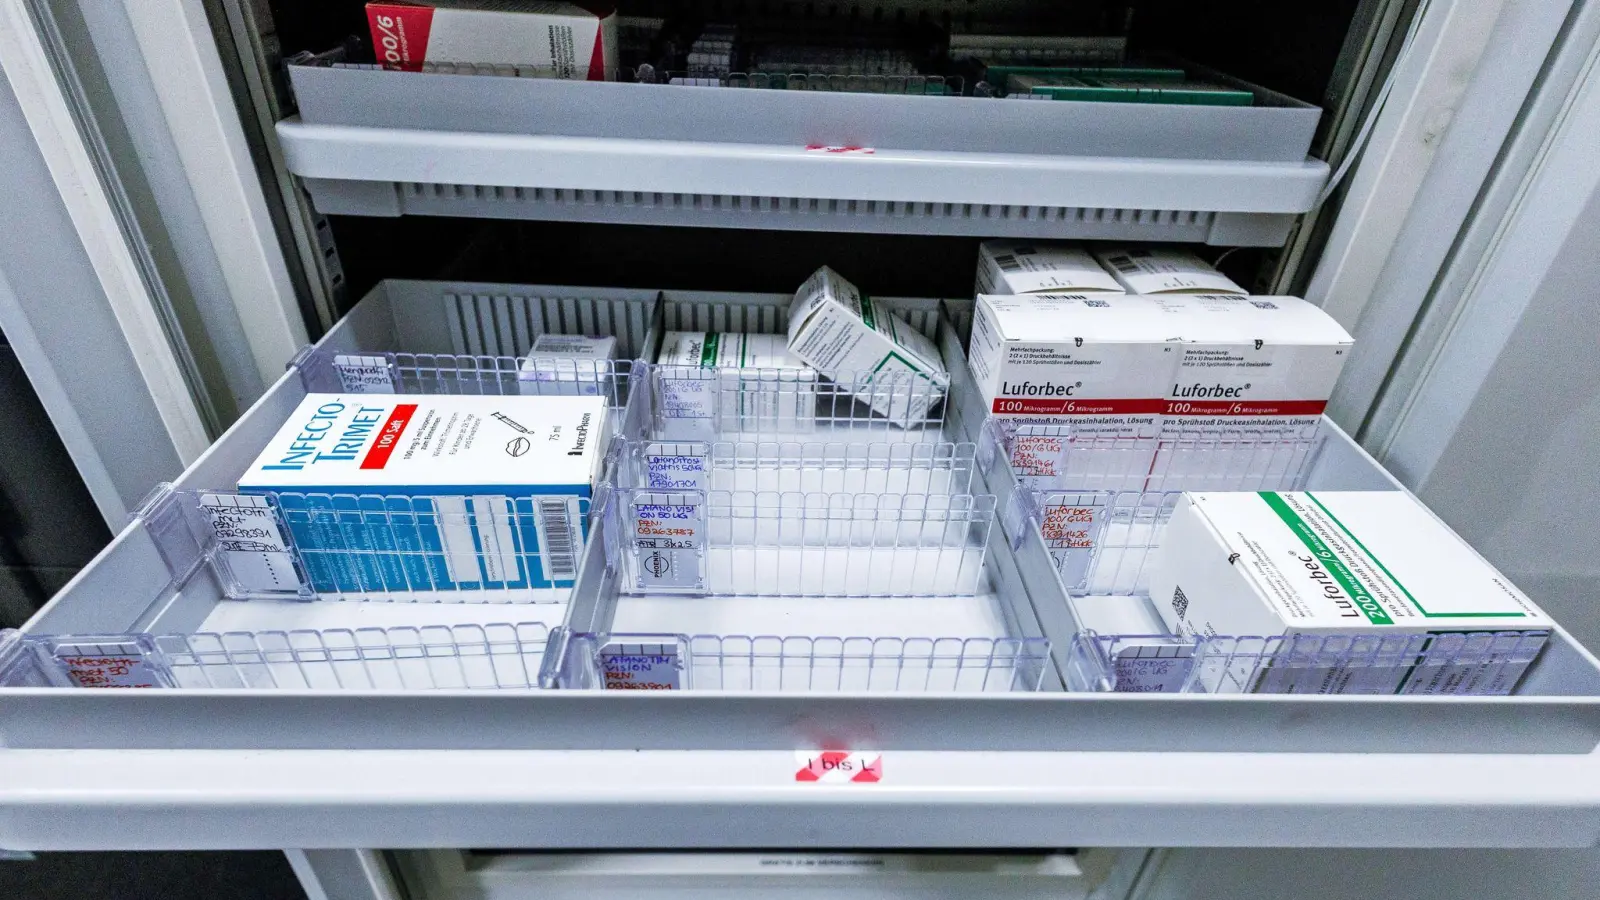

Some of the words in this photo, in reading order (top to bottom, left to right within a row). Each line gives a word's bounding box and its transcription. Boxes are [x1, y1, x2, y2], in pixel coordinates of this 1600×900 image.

[998, 401, 1023, 412] 100
[1075, 405, 1113, 413] Mikrogramm
[1166, 402, 1191, 413] 100
[1127, 416, 1154, 425] Lösung
[1162, 419, 1176, 427] pro
[1177, 418, 1215, 427] Sprühstoß
[377, 433, 393, 449] 100
[386, 419, 405, 434] Saft
[1284, 494, 1305, 511] Lösung
[637, 519, 663, 527] PZN:
[1042, 523, 1068, 531] PZN:
[637, 527, 695, 537] 09263787
[1297, 522, 1324, 551] Mikrogramm
[653, 550, 661, 578] PHOENIX
[1354, 568, 1388, 602] Sprühstoß
[1355, 594, 1382, 618] 200
[1388, 604, 1404, 616] pro
[821, 758, 853, 771] bis
[861, 758, 875, 772] L
